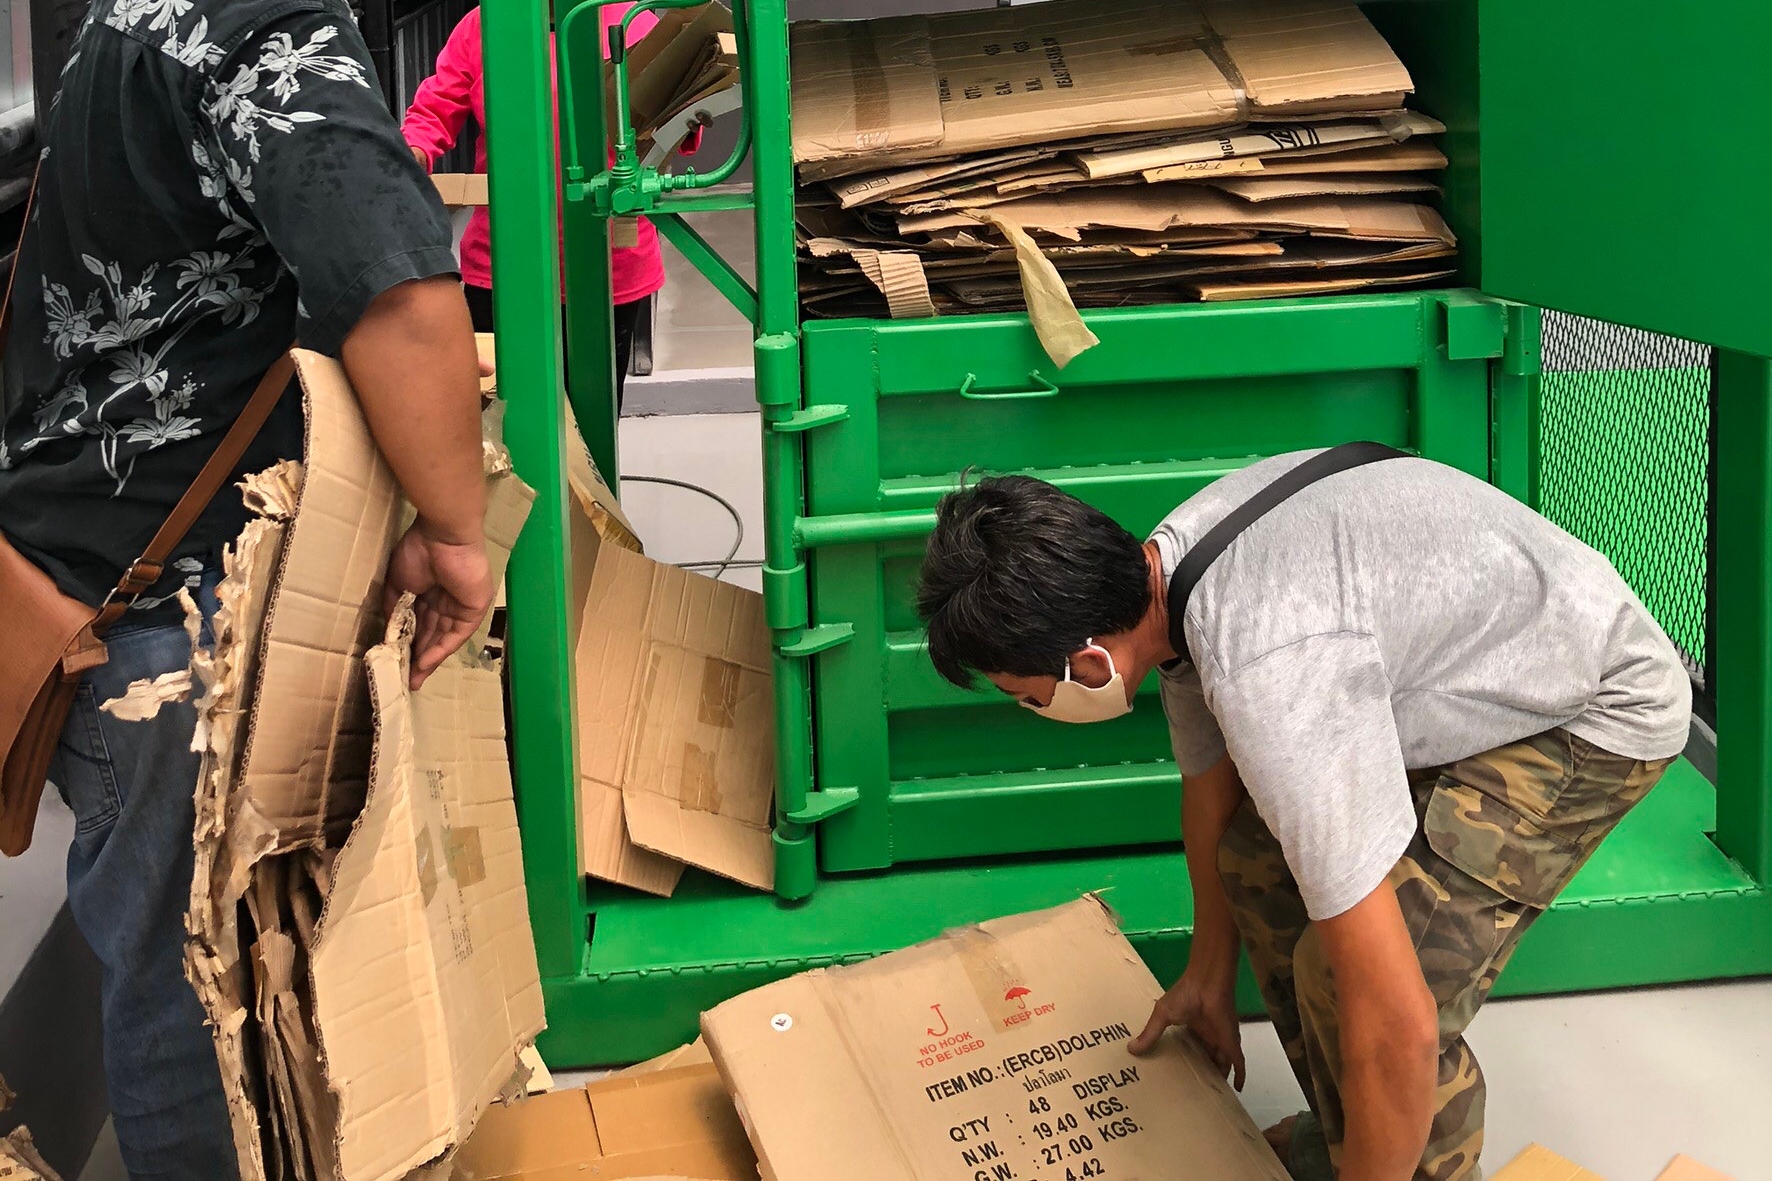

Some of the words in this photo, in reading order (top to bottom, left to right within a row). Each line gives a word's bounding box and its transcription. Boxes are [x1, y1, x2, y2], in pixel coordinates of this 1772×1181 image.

[1003, 1010, 1032, 1027] KEEP
[1034, 1002, 1056, 1017] DRY
[917, 1056, 934, 1068] TO
[935, 1051, 953, 1063] BE
[954, 1039, 986, 1056] USED
[919, 1043, 937, 1056] NO
[939, 1031, 973, 1049] HOOK
[925, 1075, 968, 1102] ITEM
[1029, 1096, 1051, 1115] 48
[1072, 1066, 1140, 1100] DISPLAY
[961, 1140, 1004, 1167] N.W.
[1032, 1113, 1078, 1140] 19.40
[1084, 1096, 1129, 1121] KGS.
[1041, 1134, 1093, 1165] 27.00
[1098, 1117, 1144, 1143] KGS.
[1065, 1158, 1106, 1181] 4.42
